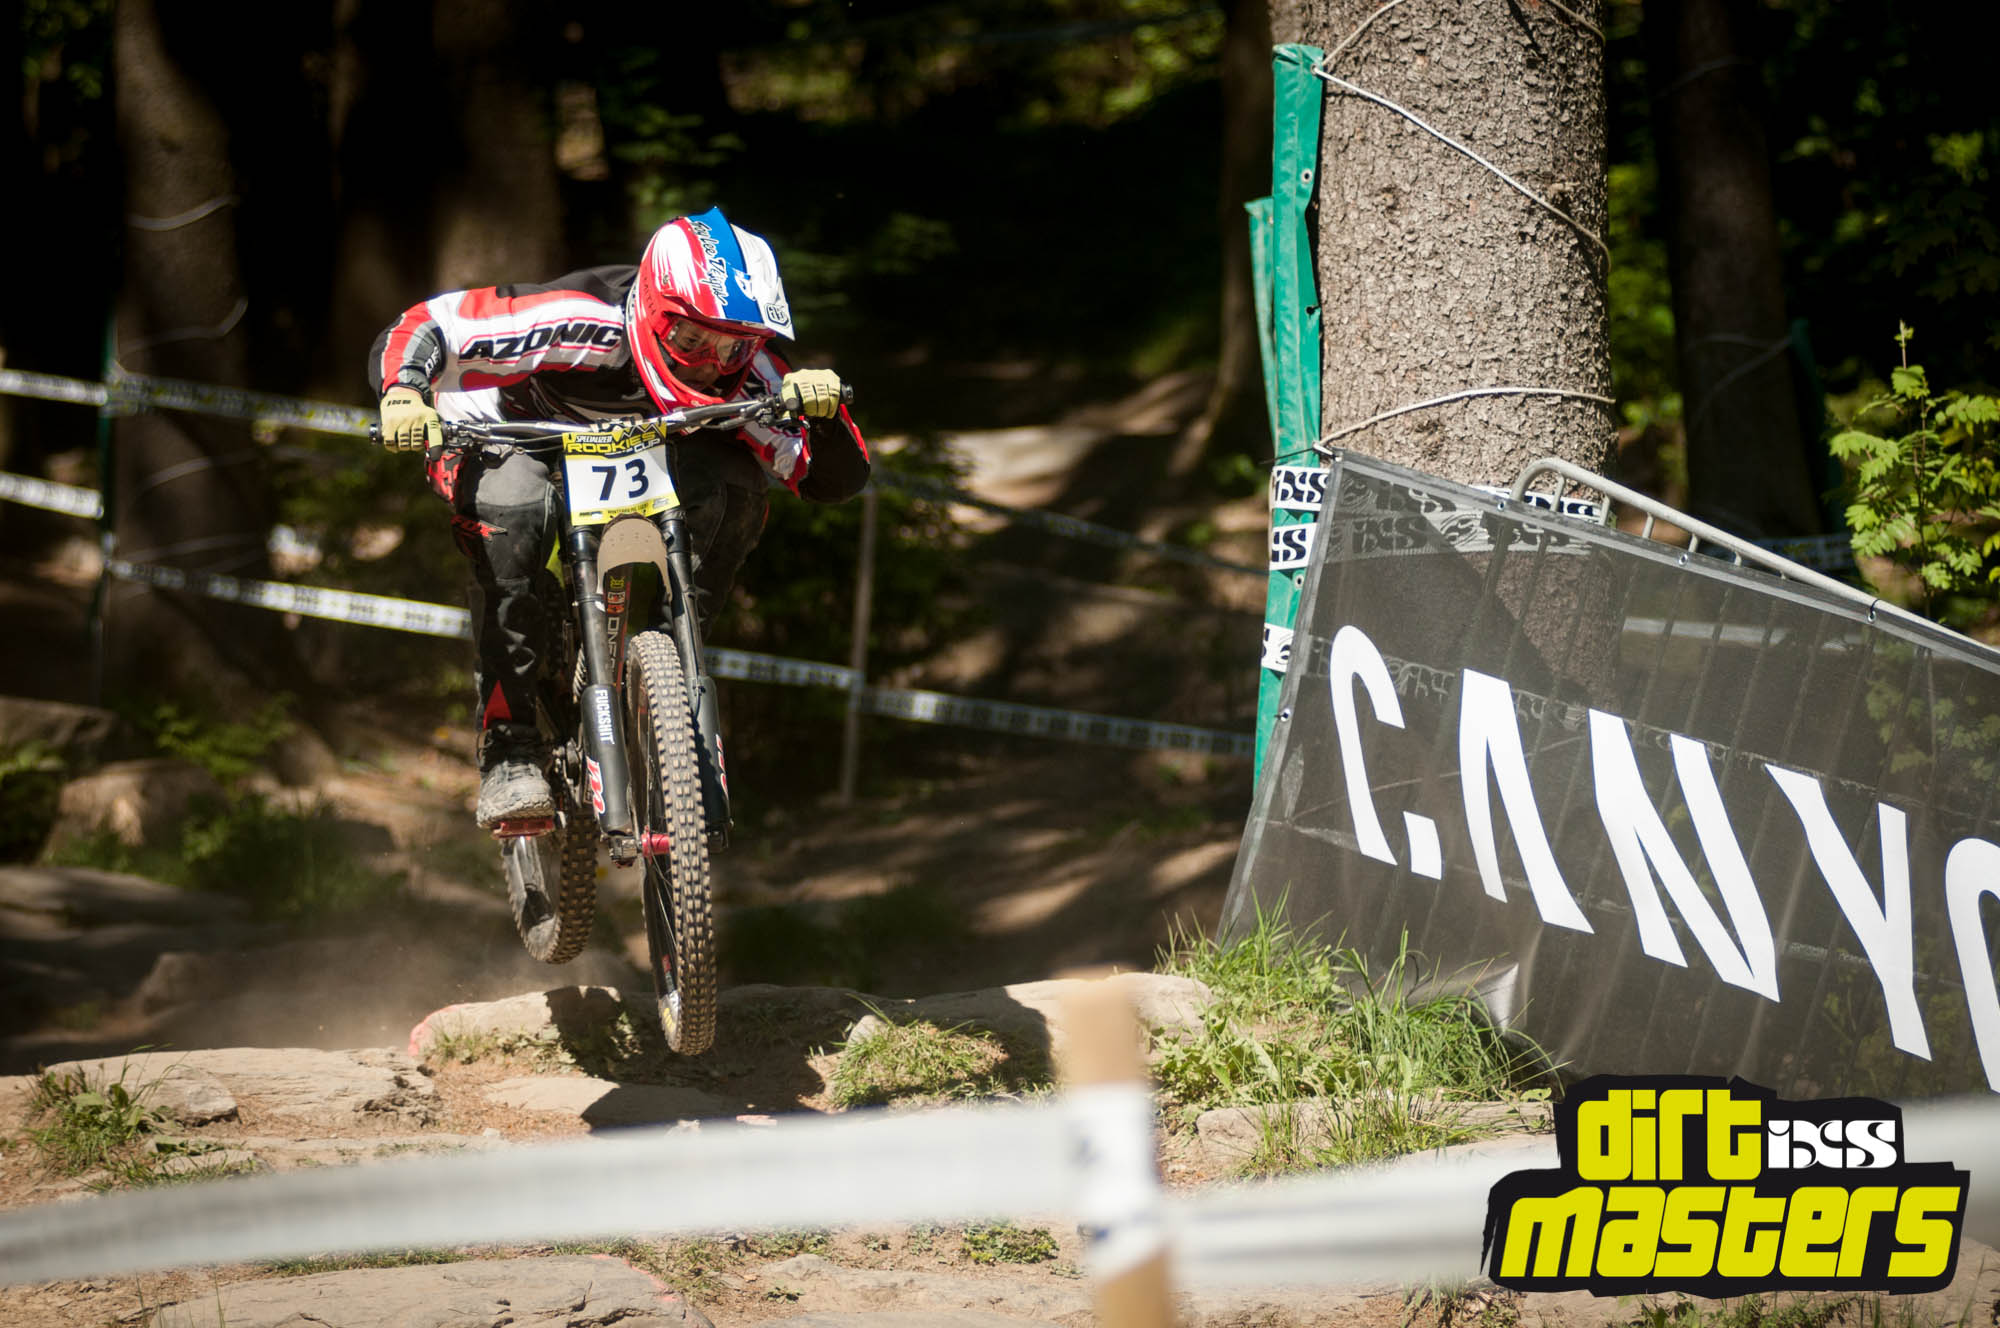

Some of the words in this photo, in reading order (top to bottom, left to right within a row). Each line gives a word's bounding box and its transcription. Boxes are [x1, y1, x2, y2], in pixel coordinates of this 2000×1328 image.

[458, 322, 624, 360] AZONIC
[567, 431, 656, 453] ROOKIES
[634, 438, 660, 453] CUP
[592, 458, 649, 501] 73
[595, 689, 615, 745] FUCKSHIT
